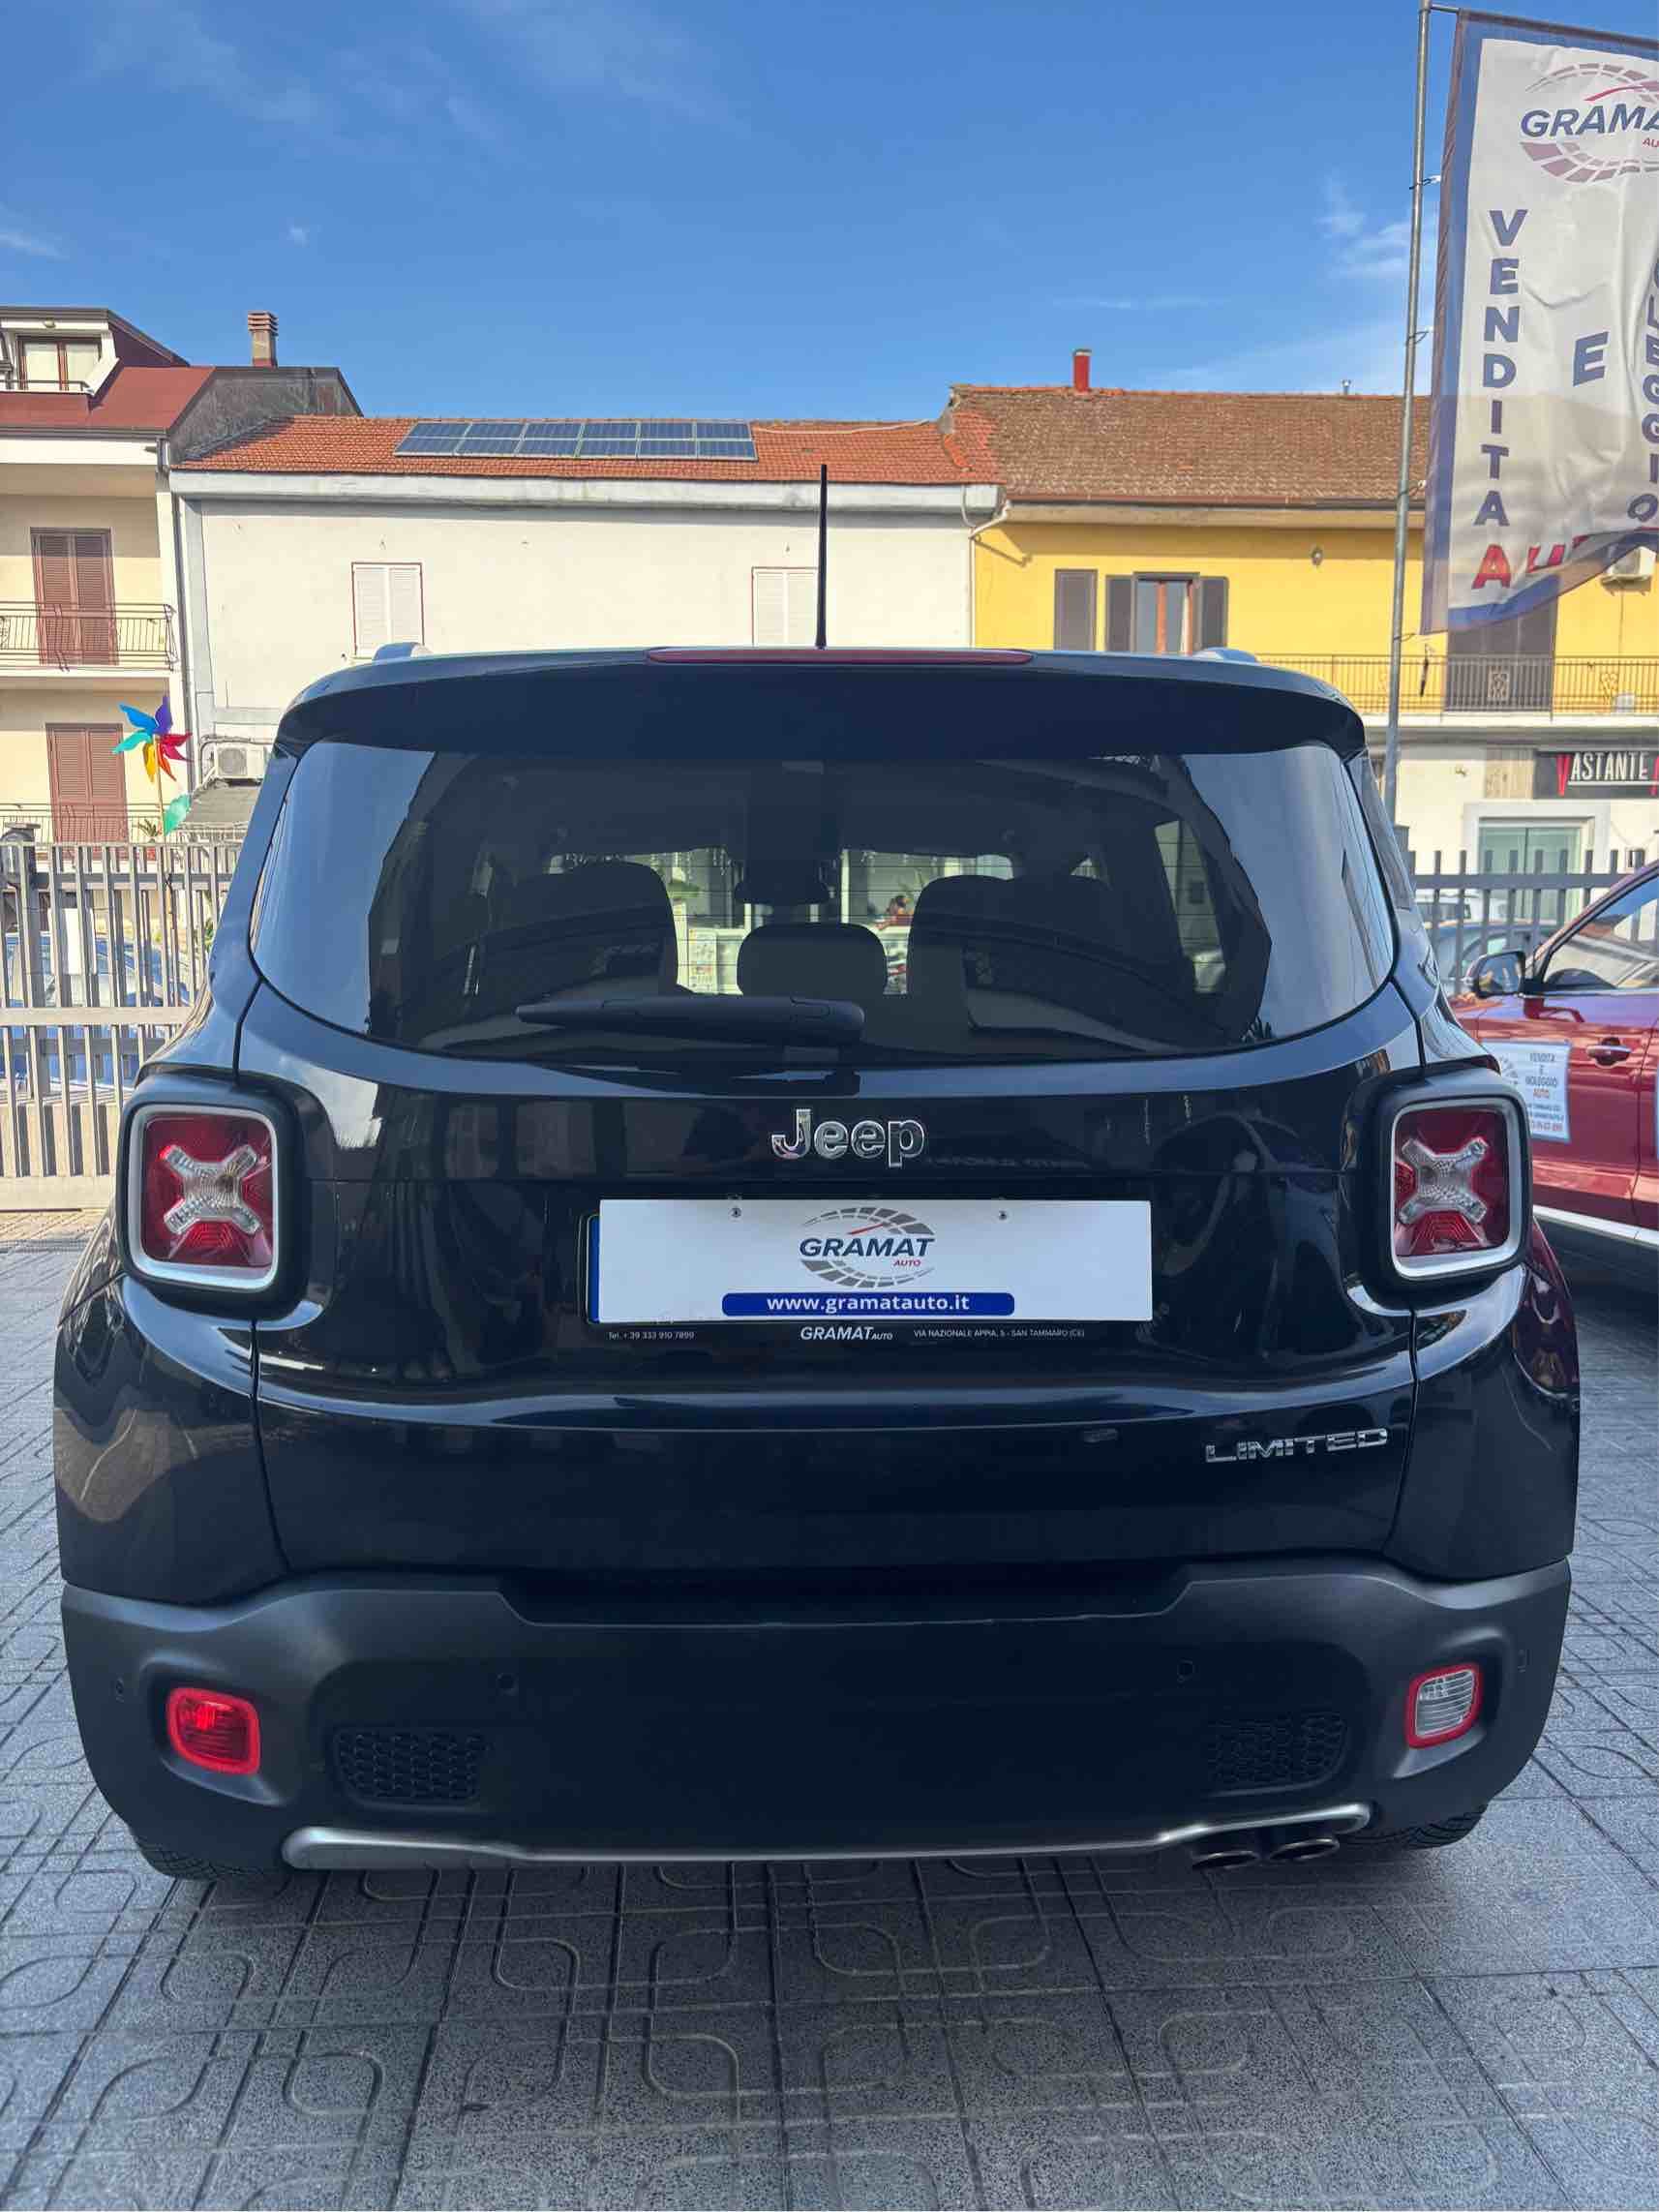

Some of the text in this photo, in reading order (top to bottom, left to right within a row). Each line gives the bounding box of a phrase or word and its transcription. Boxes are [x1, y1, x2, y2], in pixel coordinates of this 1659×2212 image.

[1473, 209, 1528, 528] VENDITA
[1573, 331, 1610, 387] E
[771, 1108, 925, 1167] Jeep
[799, 1237, 936, 1258] GRAMAT
[892, 1258, 921, 1268] AUTO
[767, 1293, 970, 1314] www.gramatauto.it
[799, 1325, 874, 1341] GRAMAT
[913, 1329, 927, 1338] VIA
[929, 1329, 972, 1338] NAZIONALE
[1206, 1428, 1388, 1463] LIMITED
